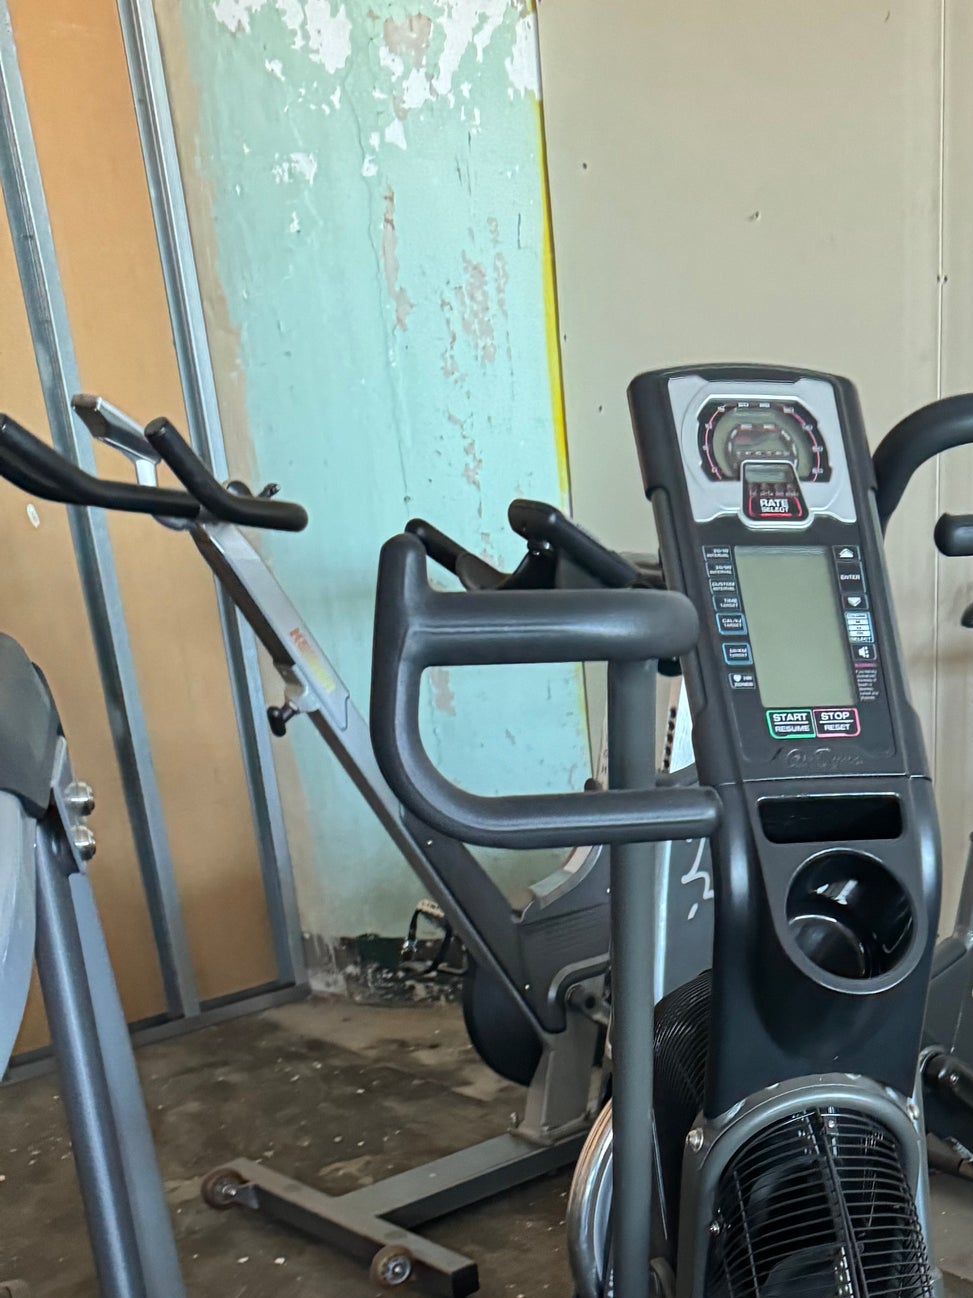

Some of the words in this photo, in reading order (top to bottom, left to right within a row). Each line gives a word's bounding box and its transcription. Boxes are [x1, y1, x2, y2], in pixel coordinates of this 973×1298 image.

[759, 498, 789, 507] RATE
[772, 712, 808, 722] START
[820, 711, 850, 720] STOP
[774, 724, 811, 732] RESUME
[823, 723, 851, 731] RESET
